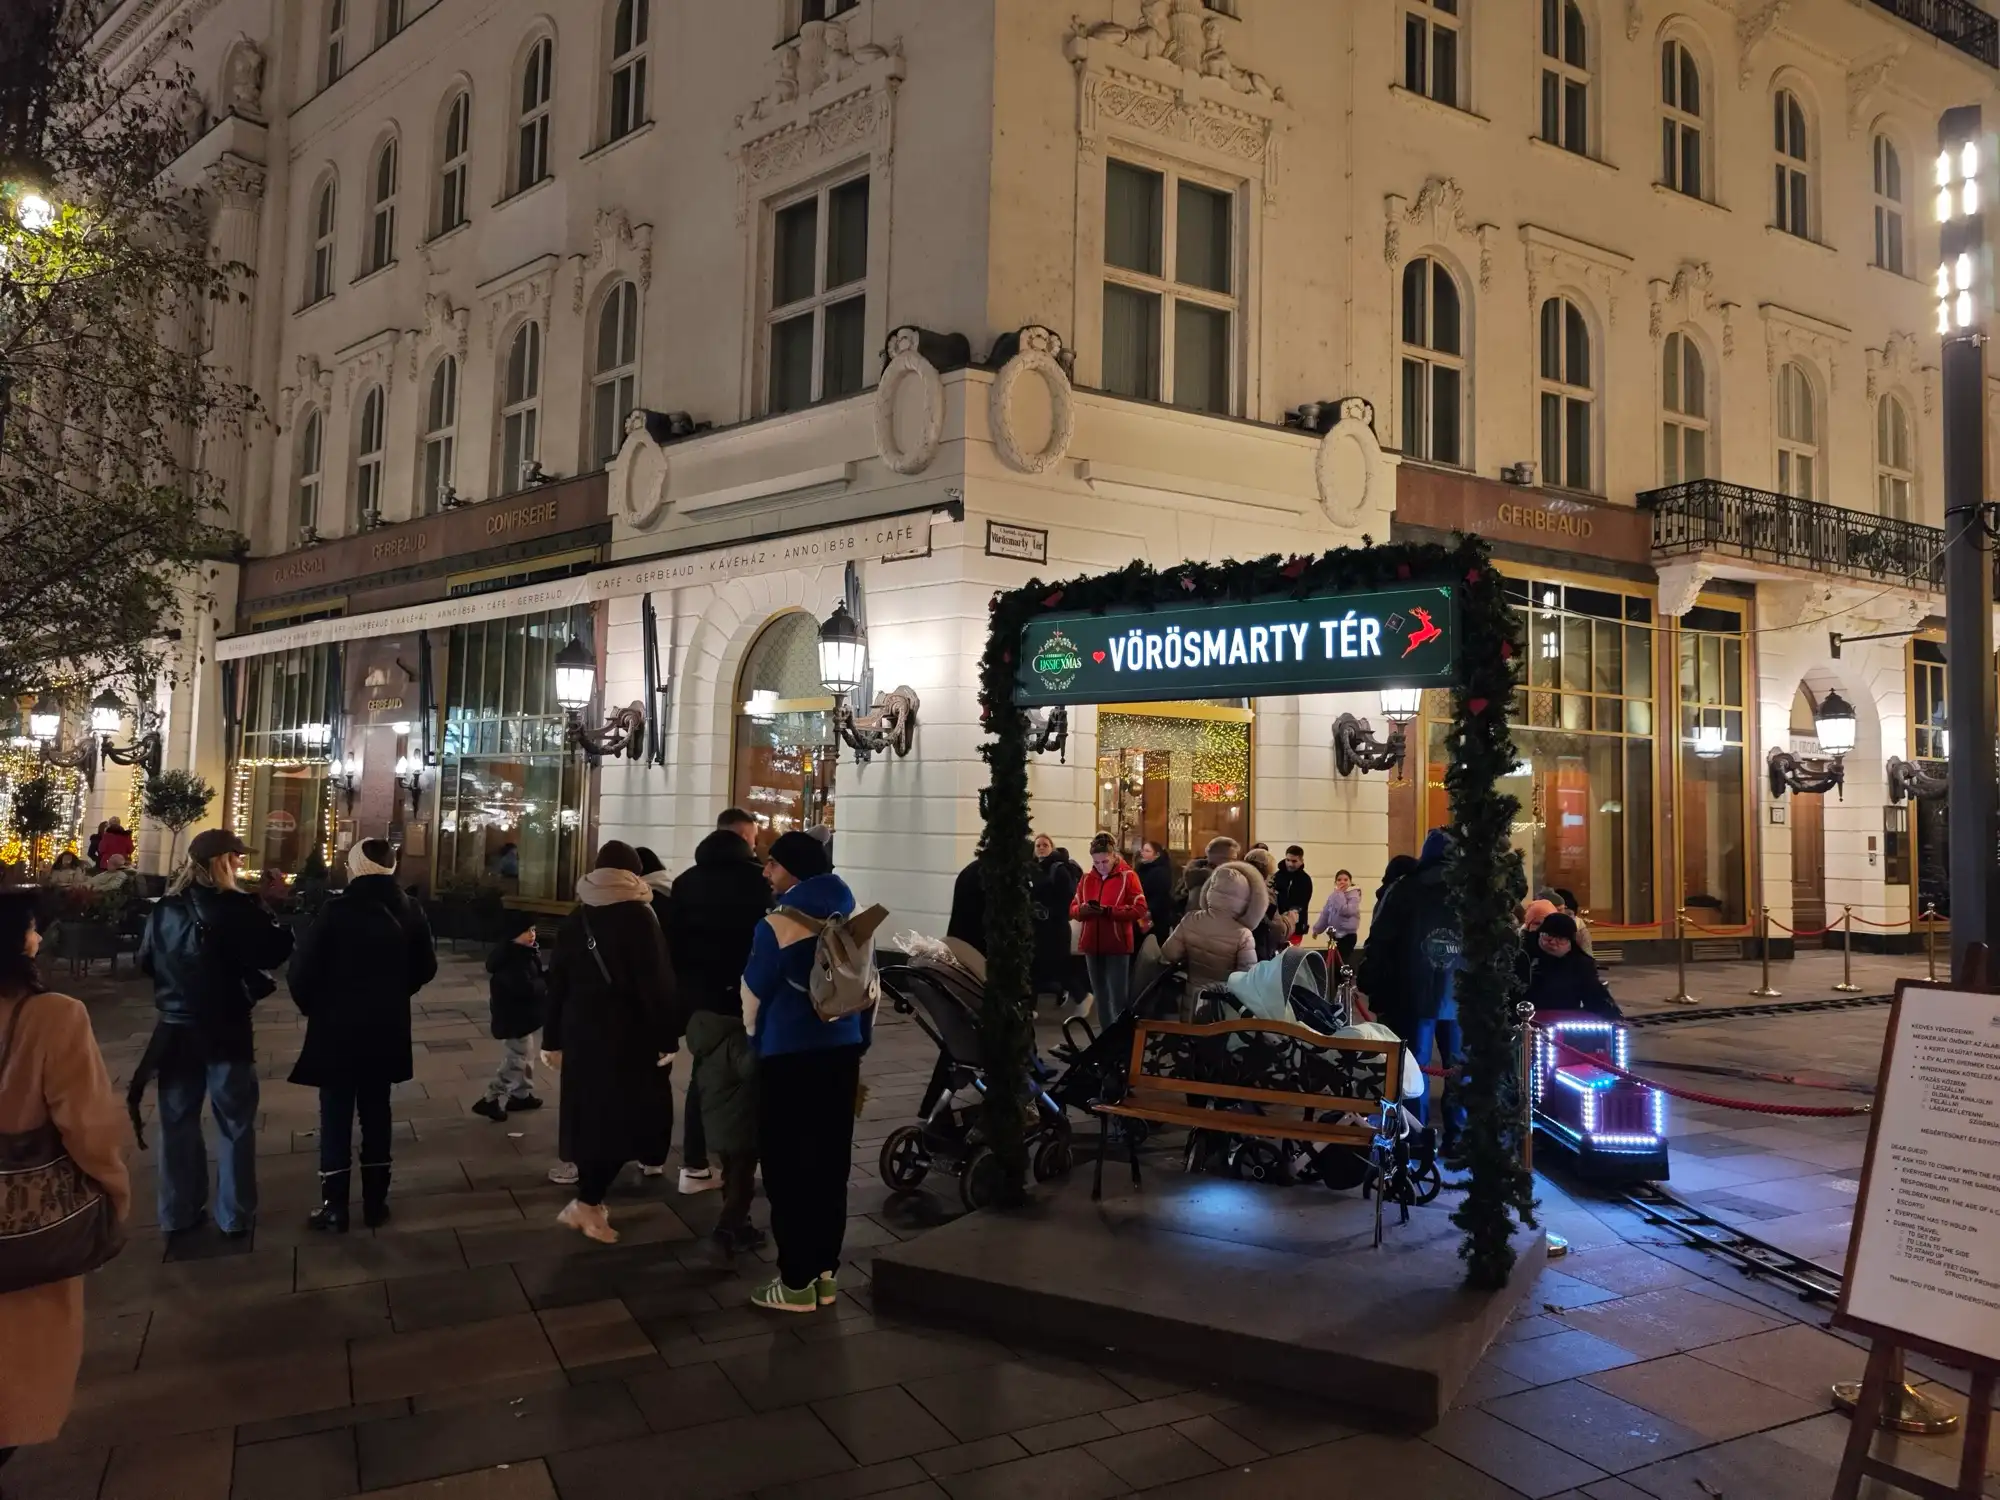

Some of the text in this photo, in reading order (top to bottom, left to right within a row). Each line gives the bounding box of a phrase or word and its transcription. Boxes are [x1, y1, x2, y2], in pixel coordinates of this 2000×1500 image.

[486, 501, 557, 535] CONFISERIE
[1498, 503, 1593, 539] GERBEAUD
[372, 533, 426, 561] GERBEAUD
[596, 576, 622, 590] CAFÉ
[636, 565, 694, 584] GERBEAUD
[783, 543, 819, 560] ANNO
[824, 536, 855, 553] 1858
[876, 526, 913, 544] CAFÉ
[517, 589, 562, 606] GERBEAUD
[1109, 610, 1381, 671] VÖRÖSMARTY TÉR
[368, 698, 403, 711] GERBEAUD
[1911, 1023, 1934, 1031] KEDVES
[1890, 1143, 1906, 1151] DEAR
[1902, 1167, 1933, 1178] EVERYONE
[1933, 1173, 1947, 1181] CAN
[1948, 1176, 1960, 1184] USE
[1961, 1179, 1974, 1187] THE
[1936, 1163, 1961, 1173] COMPLY
[1962, 1168, 1978, 1177] WITH
[1979, 1171, 1991, 1179] THE
[1899, 1188, 1929, 1199] CHILDREN
[1929, 1195, 1950, 1204] UNDER
[1964, 1203, 1978, 1211] AGE
[1893, 1219, 1940, 1236] DURING TRAVEL
[1894, 1209, 1926, 1221] EVERYONE
[1926, 1216, 1939, 1225] HAS
[1950, 1222, 1967, 1231] HOLD
[1968, 1225, 1978, 1233] ON
[1917, 1232, 1928, 1240] GET
[1929, 1235, 1942, 1243] OFF
[1905, 1244, 1913, 1252] TO
[1914, 1247, 1934, 1257] STAND
[1916, 1239, 1931, 1249] LEAN
[1942, 1246, 1954, 1255] THE
[1955, 1249, 1970, 1258] SIDE
[1904, 1251, 1979, 1276] TO PUT YOUR FEET DOWN
[1889, 1274, 1909, 1284] THANK
[1910, 1279, 1922, 1288] YOU
[1923, 1283, 1936, 1292] FOR
[1937, 1287, 1954, 1297] YOUR
[1944, 1270, 1973, 1282] STRICTLY
